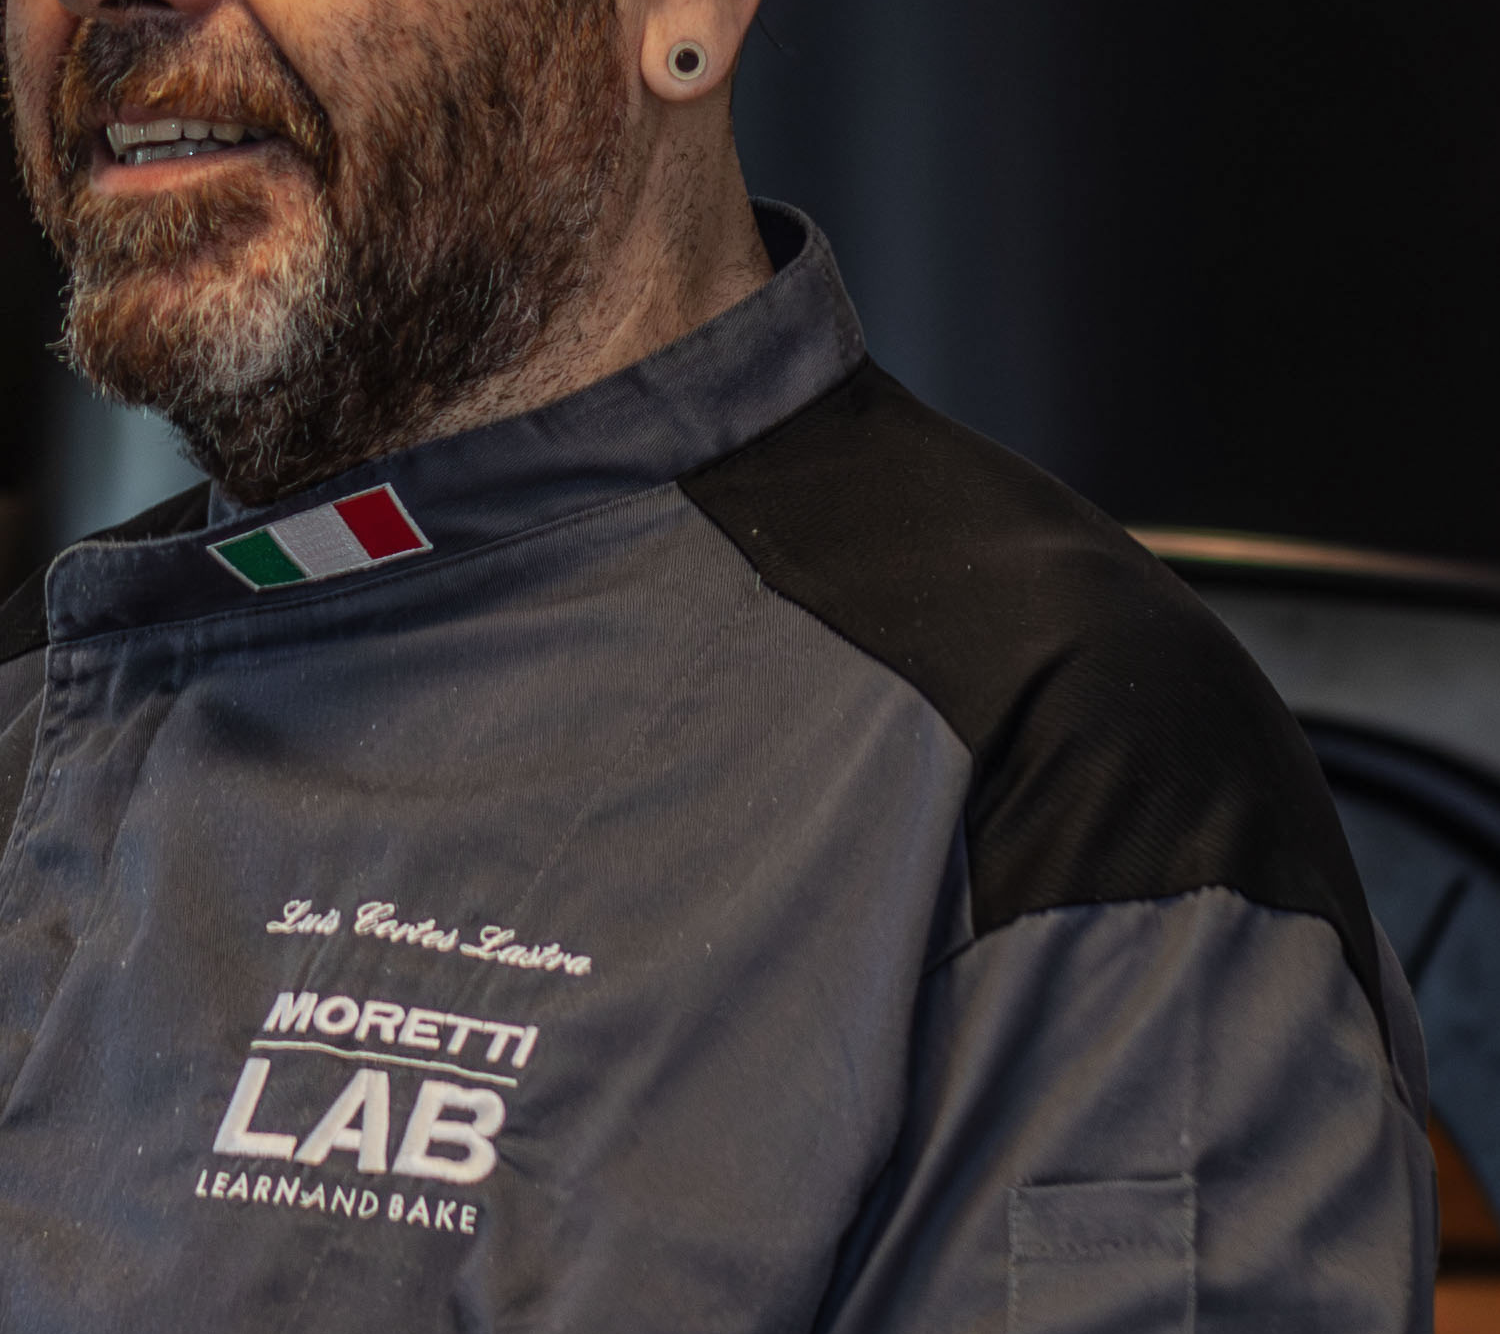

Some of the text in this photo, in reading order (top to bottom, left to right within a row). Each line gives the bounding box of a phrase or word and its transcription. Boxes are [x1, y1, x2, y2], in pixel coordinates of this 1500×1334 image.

[262, 991, 539, 1069] MORETTI
[212, 1056, 506, 1185] LAB
[194, 1168, 478, 1235] LEARN AND BAKE
